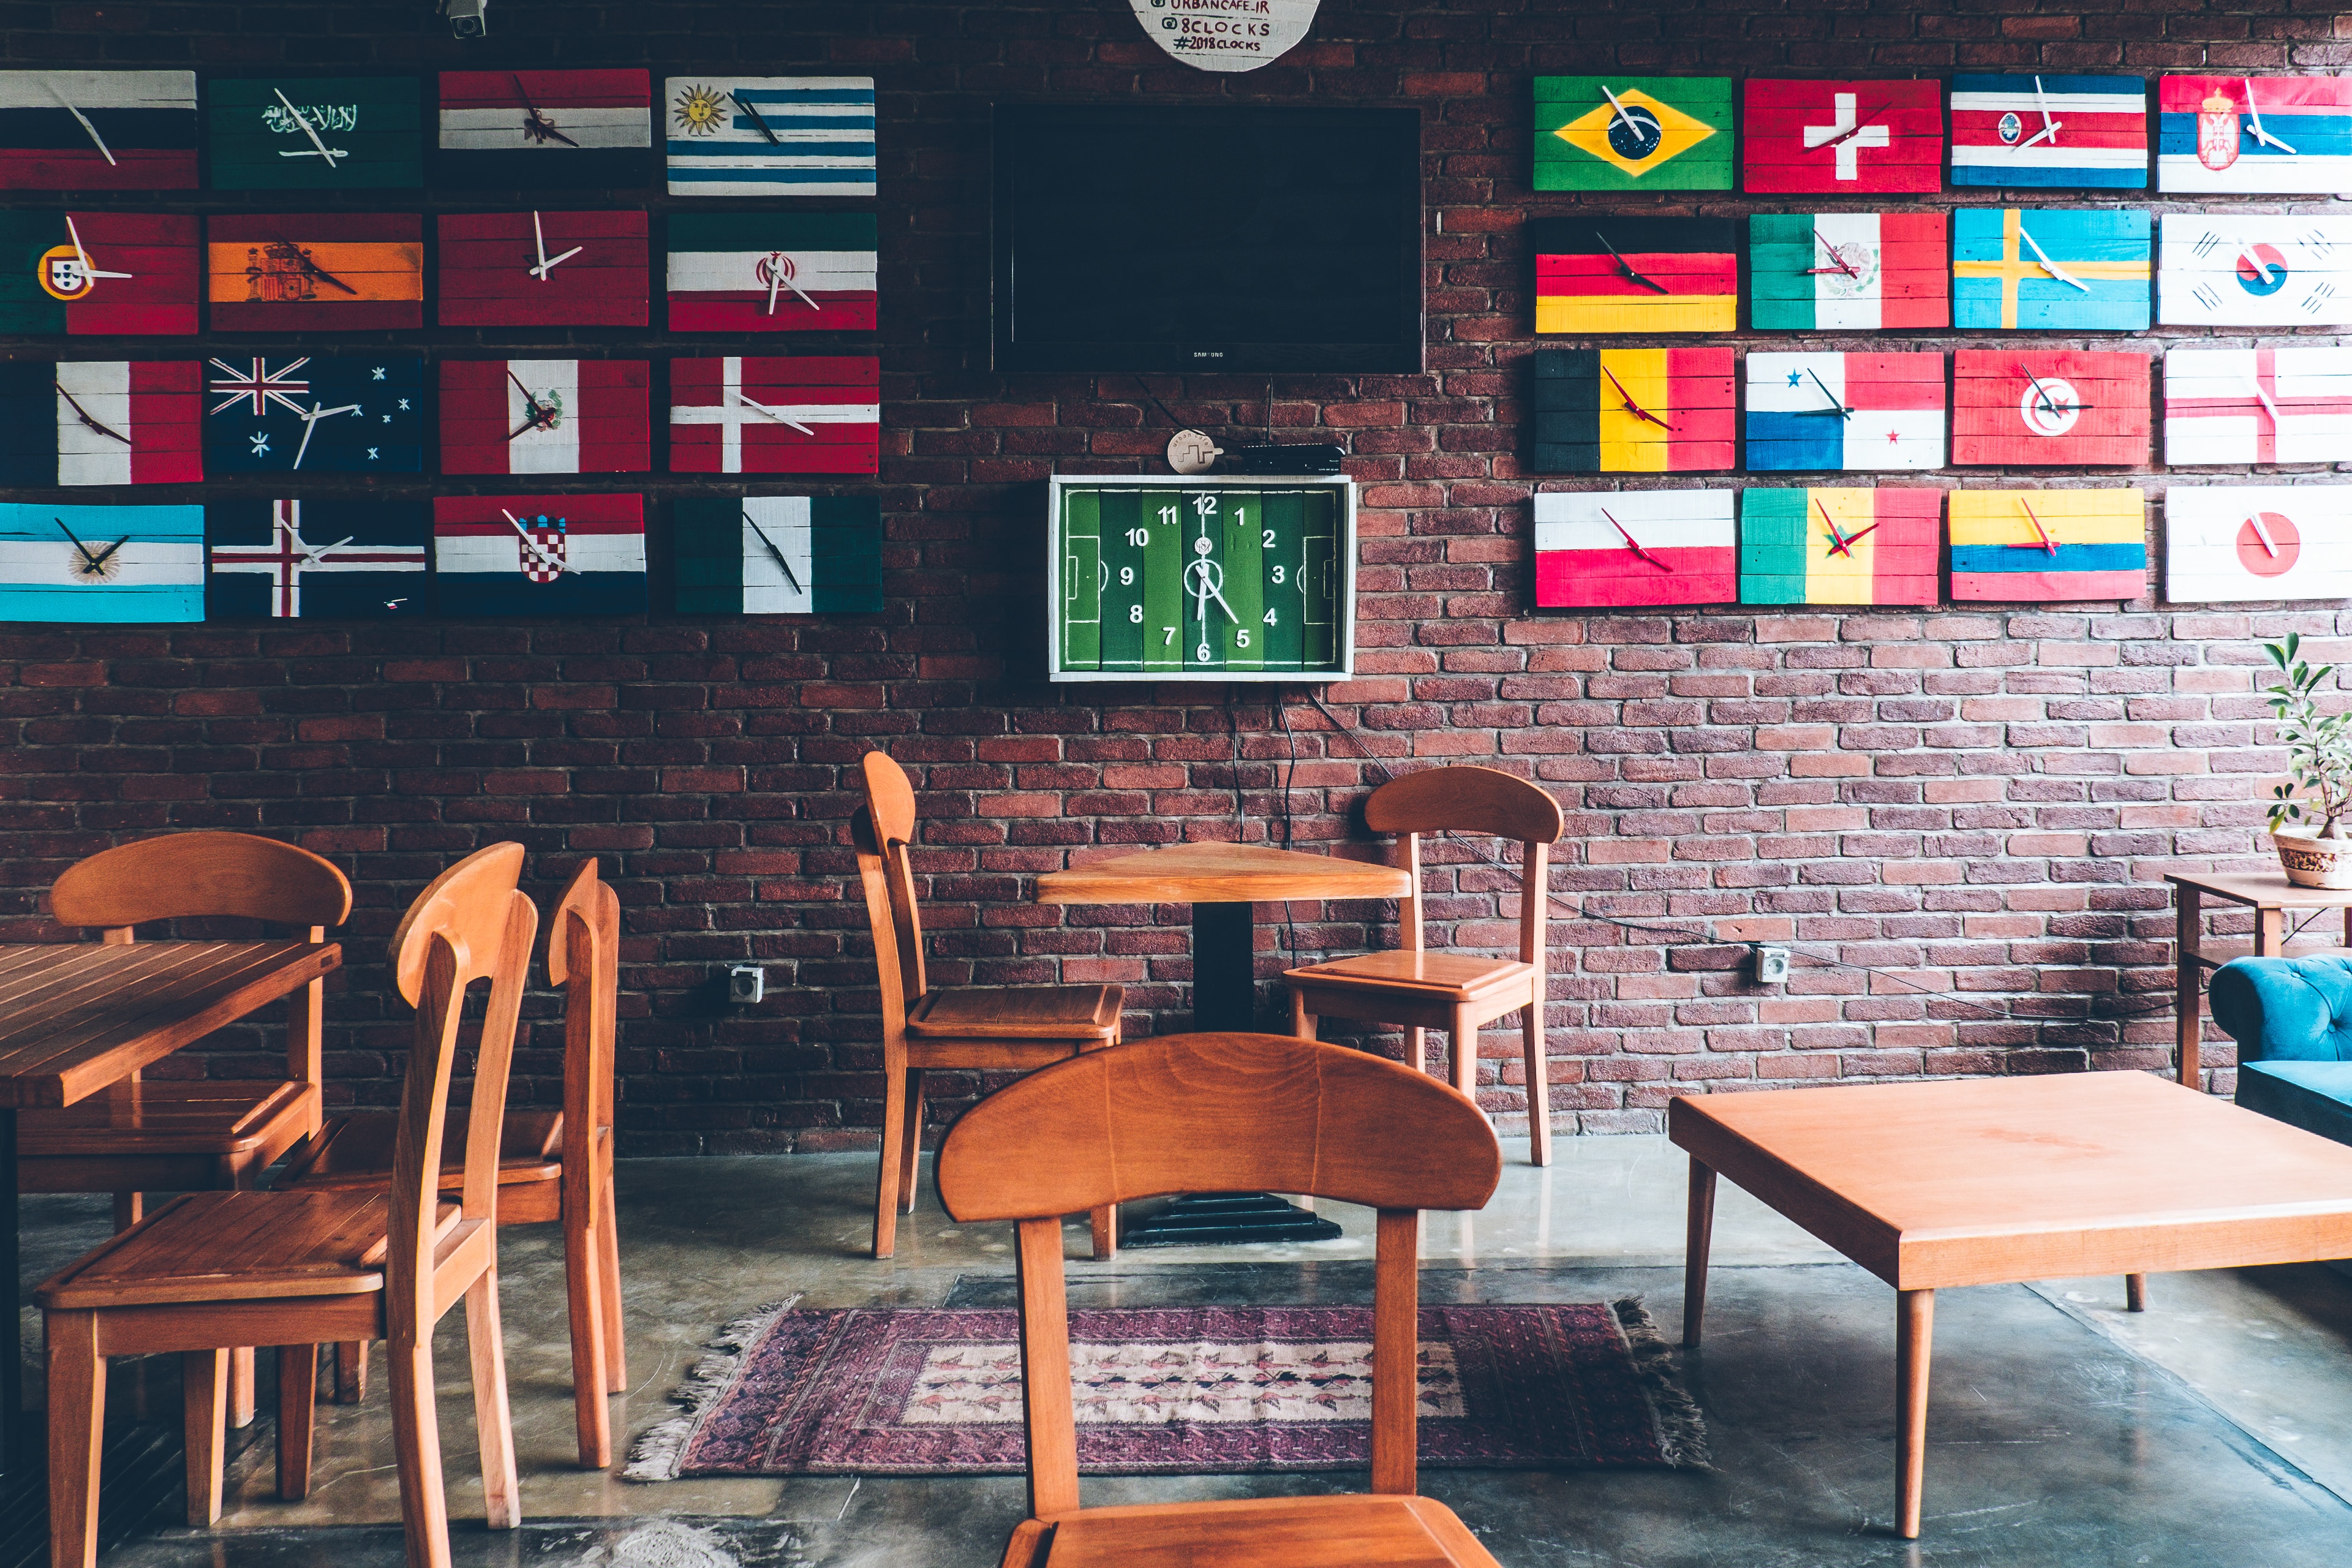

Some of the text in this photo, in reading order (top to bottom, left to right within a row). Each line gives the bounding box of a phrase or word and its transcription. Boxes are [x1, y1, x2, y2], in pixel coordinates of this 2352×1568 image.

[1173, 36, 1261, 51] #2018CLOCKS
[1172, 433, 1191, 447] urban
[1192, 496, 1217, 514] 12
[1157, 505, 1177, 525] 11
[1234, 507, 1245, 526] 1
[1125, 528, 1149, 547] 10
[1262, 529, 1276, 548] 2
[1120, 567, 1134, 586] 9
[1272, 565, 1285, 584] 3
[1129, 605, 1144, 624] 8
[1262, 608, 1278, 627] 4
[1163, 627, 1177, 646] 7
[1236, 630, 1251, 648] 5
[1197, 643, 1210, 662] 6
